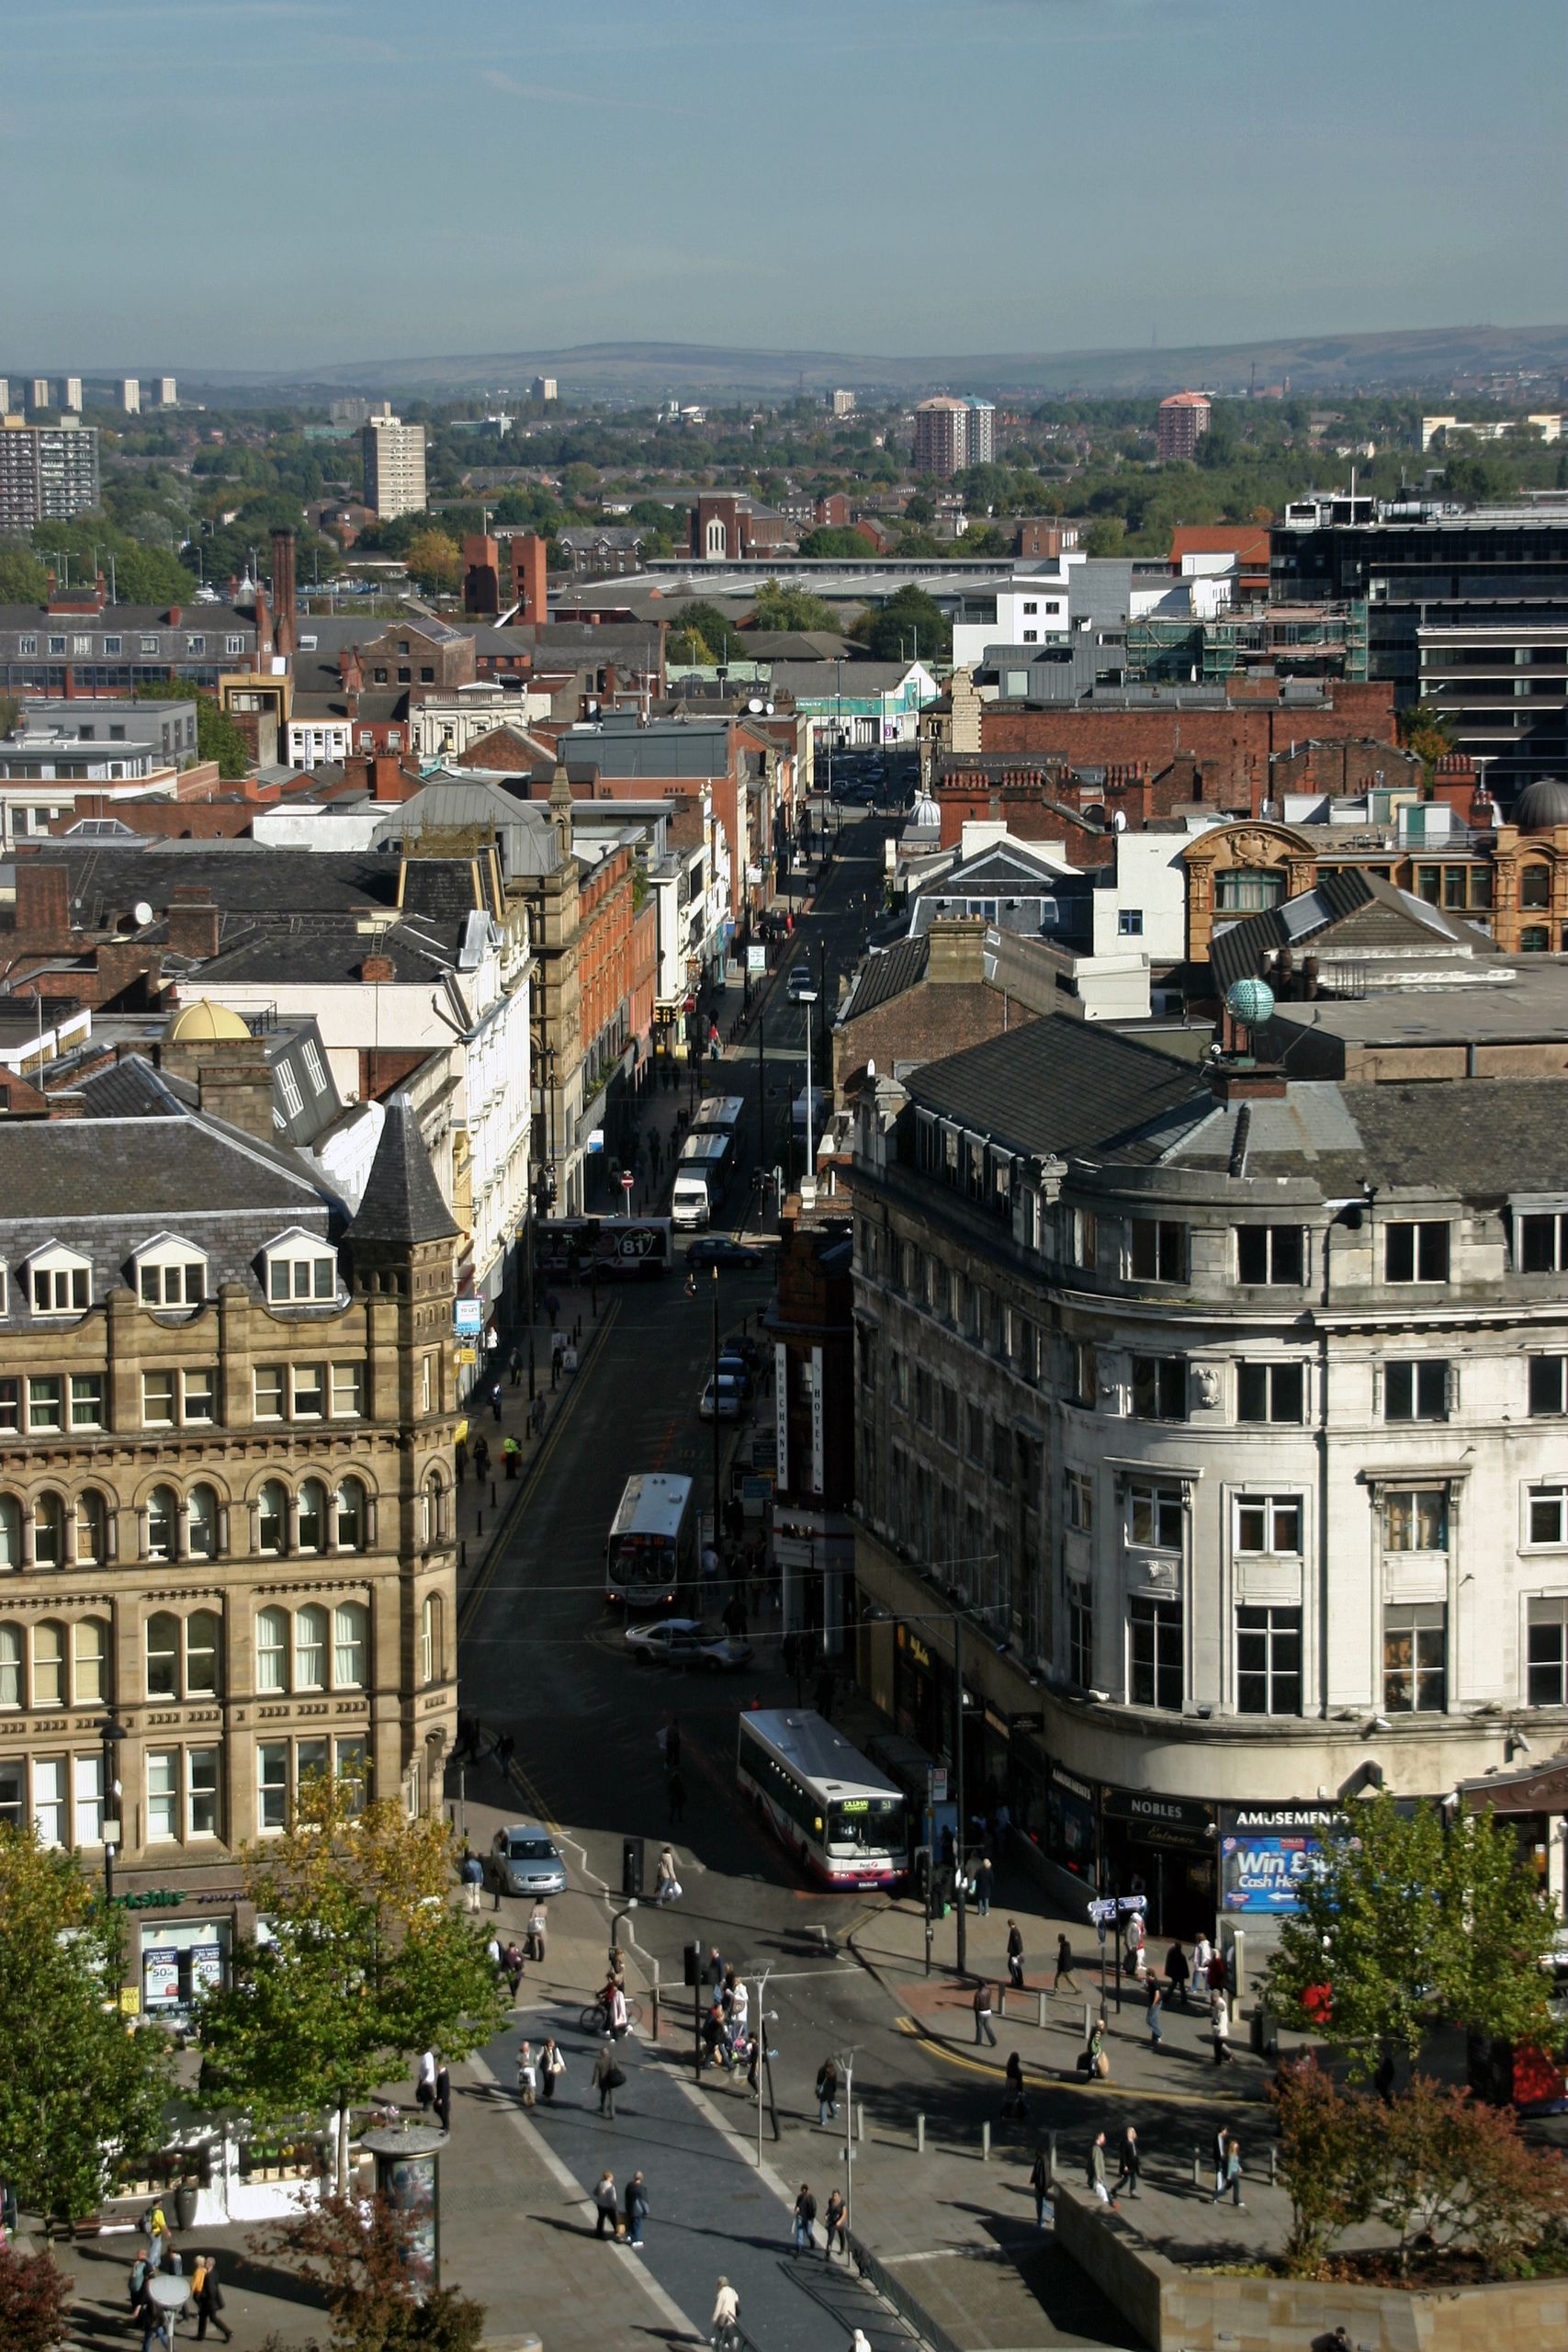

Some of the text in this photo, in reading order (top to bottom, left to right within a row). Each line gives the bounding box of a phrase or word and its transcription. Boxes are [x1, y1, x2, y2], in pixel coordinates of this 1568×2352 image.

[623, 1240, 645, 1255] 81
[777, 1359, 785, 1475] MERCHANTS
[1052, 1768, 1091, 1801] AMUSEMENTS
[1131, 1799, 1182, 1819] NOBLES
[1237, 1851, 1285, 1873] Win
[1238, 1874, 1273, 1888] Cash
